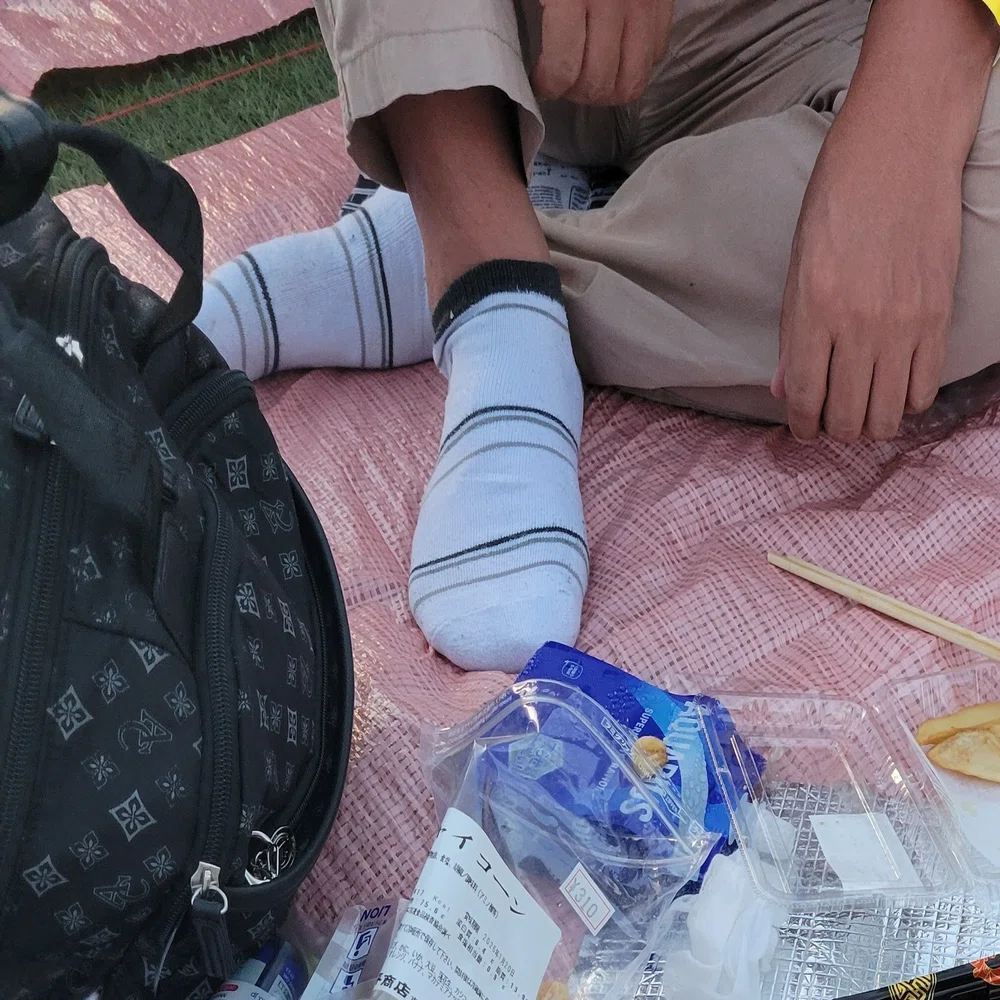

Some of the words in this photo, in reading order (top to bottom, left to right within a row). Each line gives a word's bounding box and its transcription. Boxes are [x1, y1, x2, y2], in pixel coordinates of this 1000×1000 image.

[438, 827, 526, 917] イコーン
[359, 904, 391, 922] LION
[564, 879, 598, 916] ¥310
